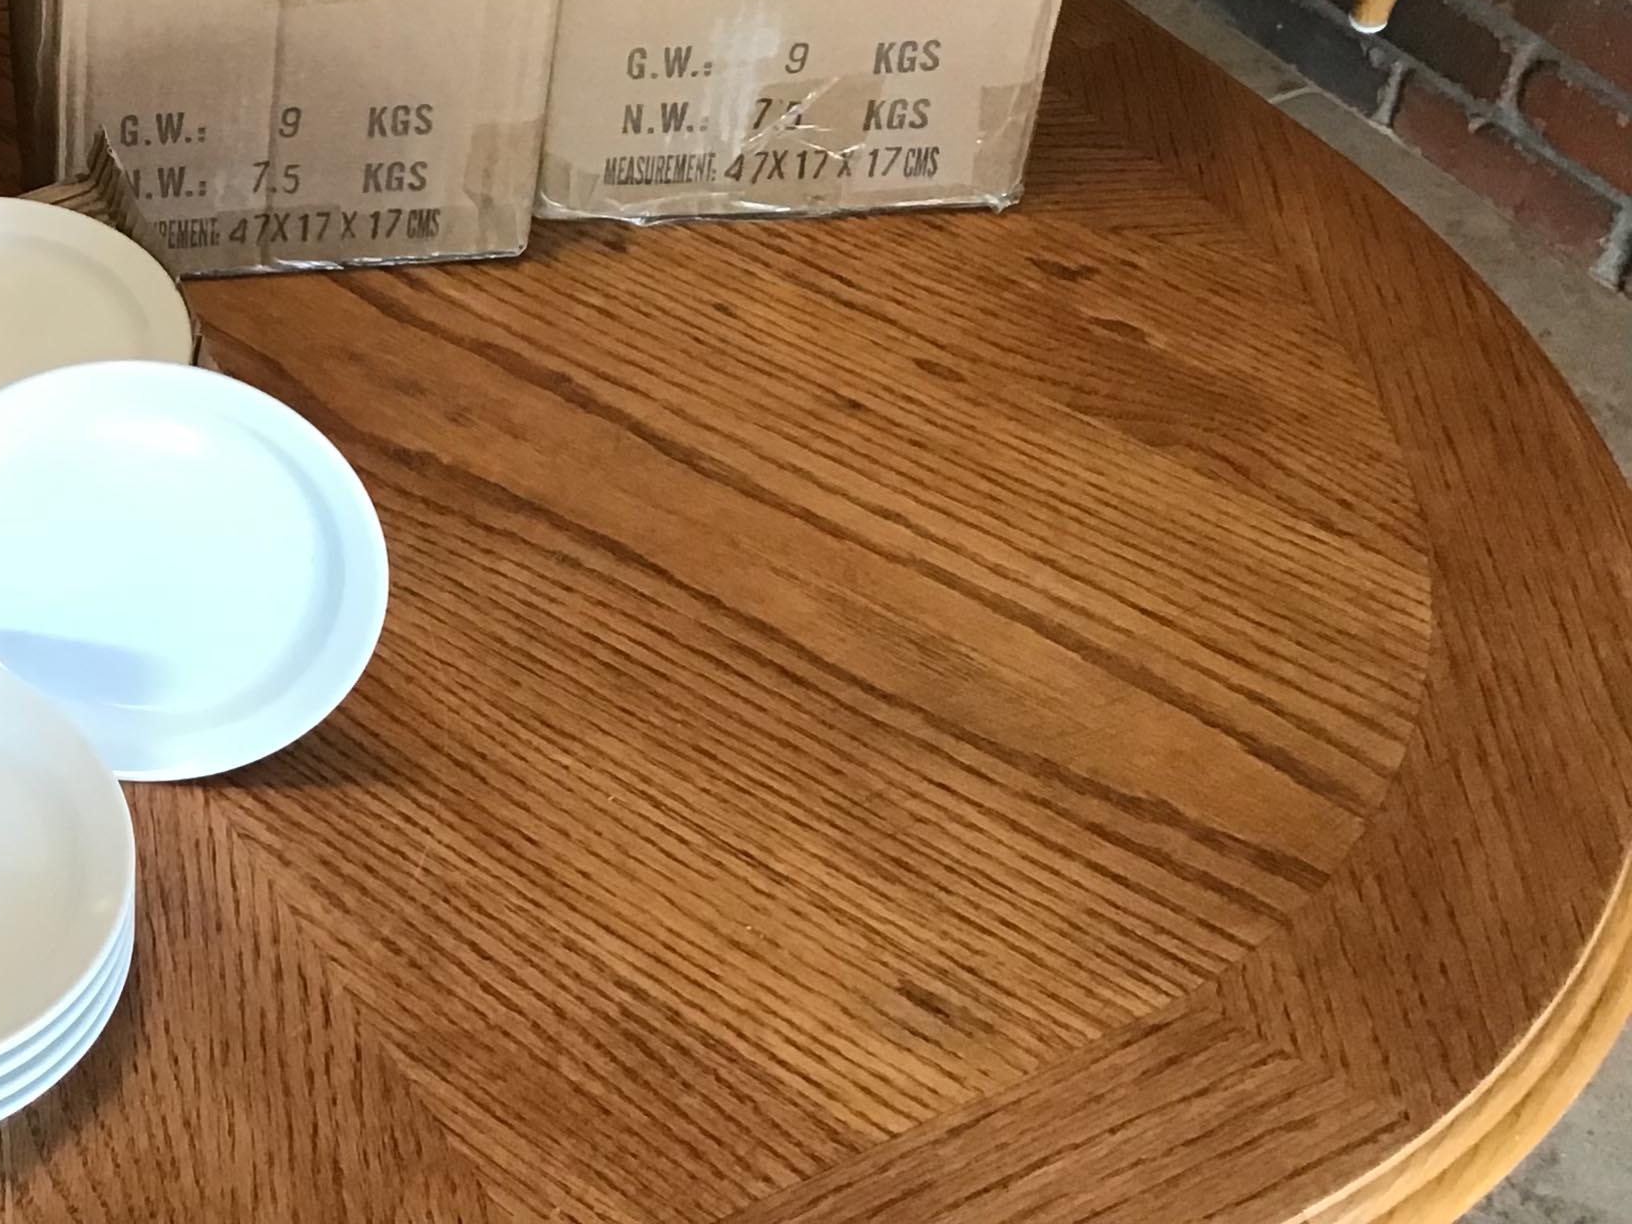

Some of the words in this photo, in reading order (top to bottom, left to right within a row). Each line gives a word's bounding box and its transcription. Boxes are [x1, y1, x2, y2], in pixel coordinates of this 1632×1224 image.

[626, 45, 713, 80] G.W.:
[784, 41, 810, 75] 9
[873, 39, 942, 75] KGS
[119, 111, 208, 148] G.W.:
[278, 106, 302, 139] 9
[367, 103, 434, 139] KGS
[862, 98, 932, 132] KGS
[252, 160, 302, 195] 7.5
[361, 160, 429, 194] KGS
[603, 152, 718, 186] MEASUREMENT:
